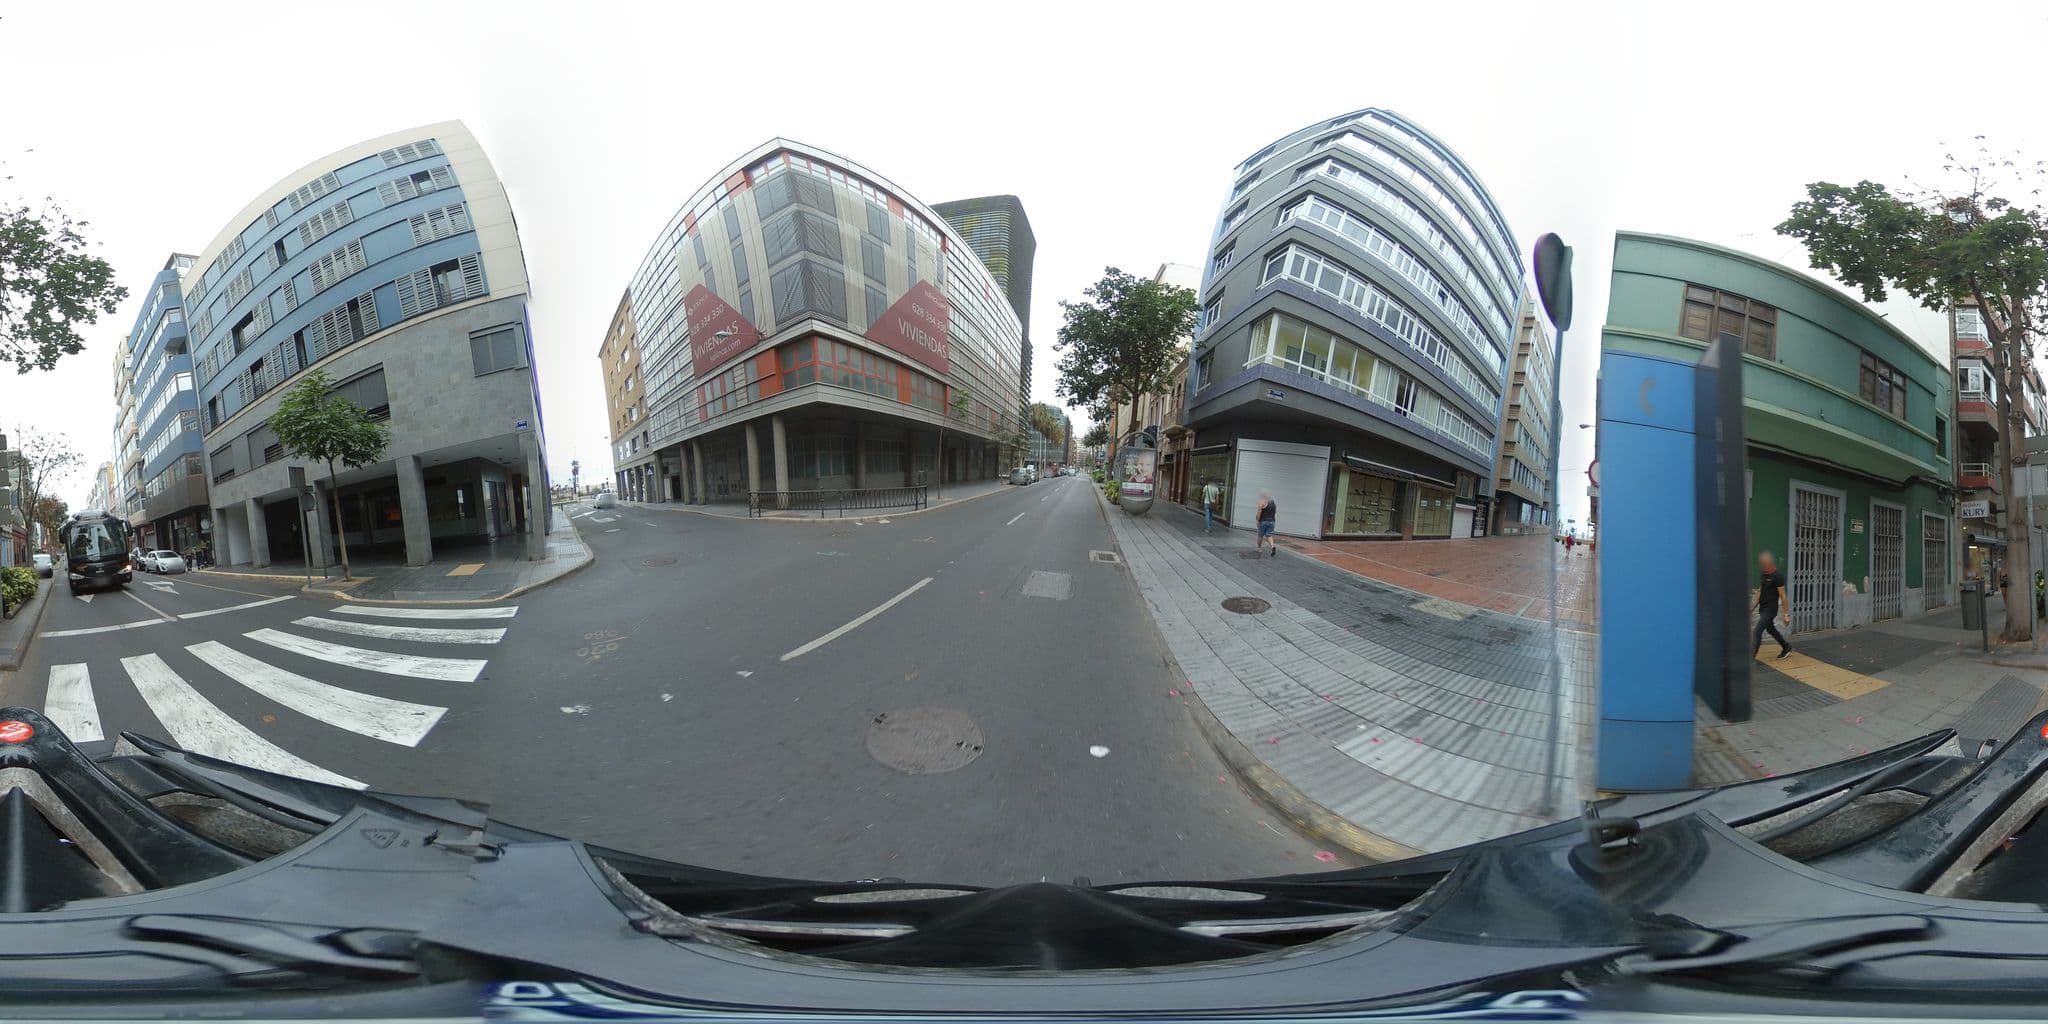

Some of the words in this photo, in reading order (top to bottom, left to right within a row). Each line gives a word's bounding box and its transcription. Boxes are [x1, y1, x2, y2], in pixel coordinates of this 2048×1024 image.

[912, 302, 925, 318] 628
[700, 313, 711, 328] 334
[898, 317, 947, 359] VIVIENDAS
